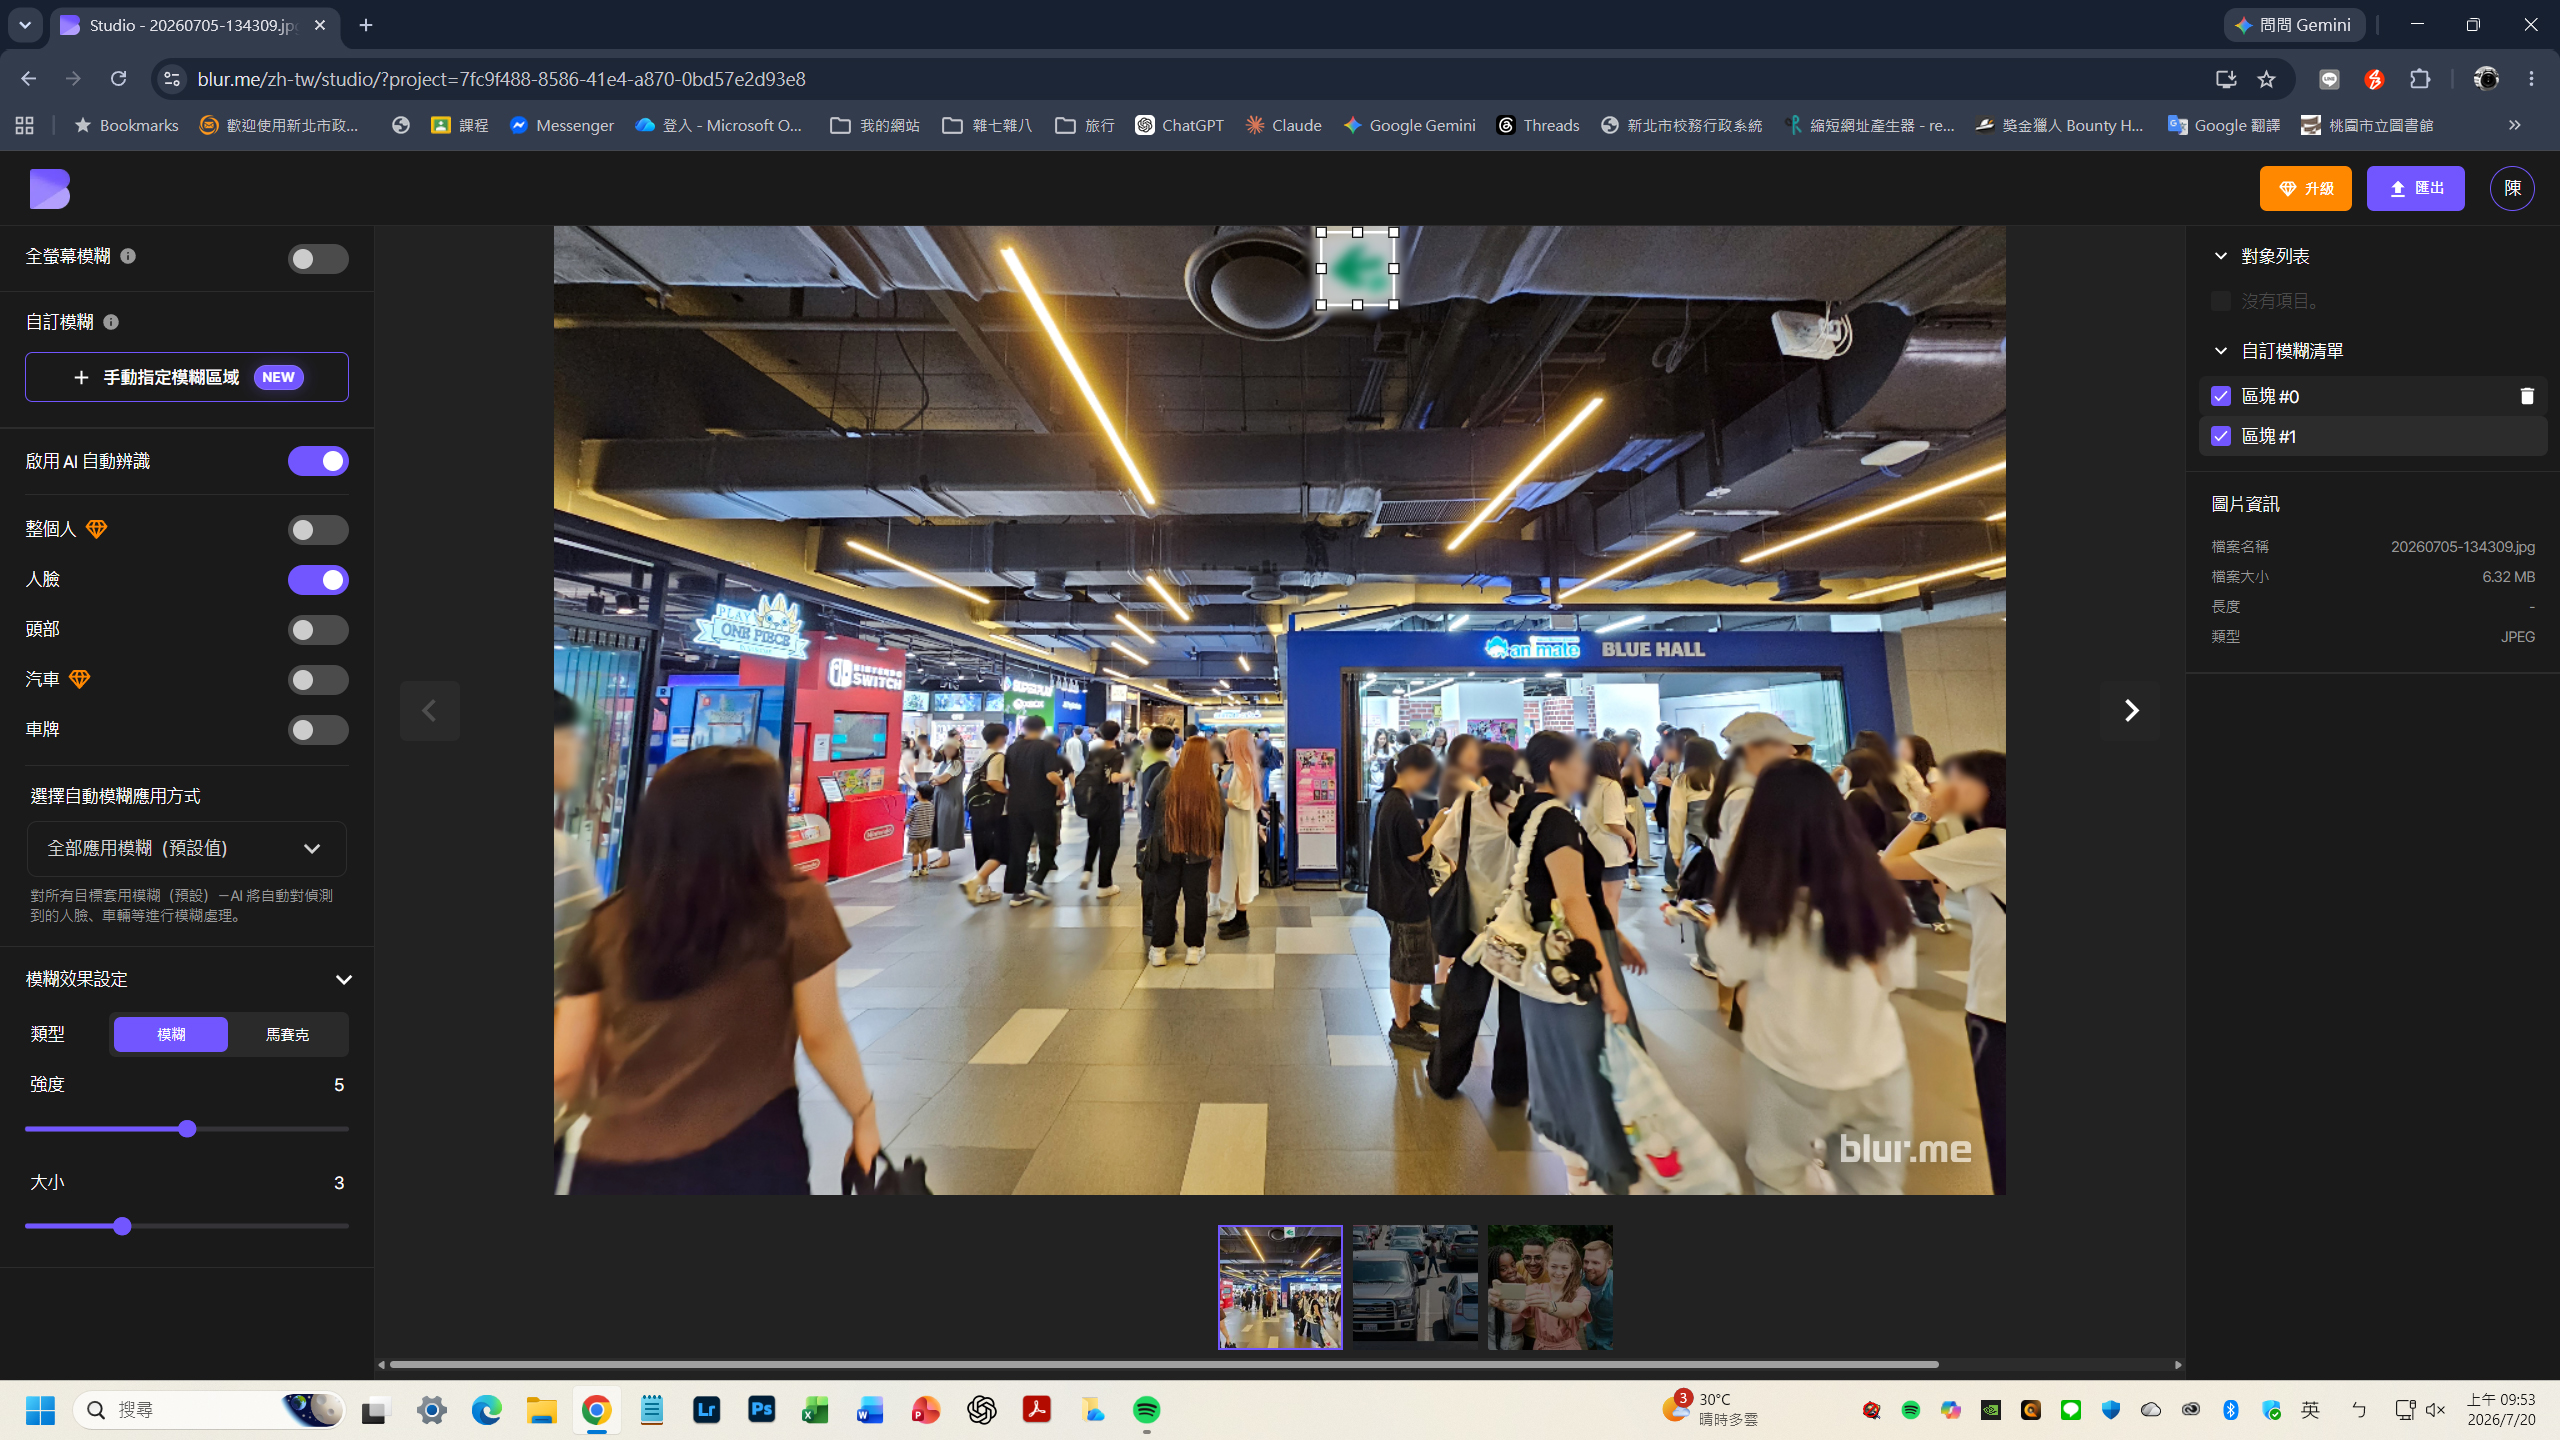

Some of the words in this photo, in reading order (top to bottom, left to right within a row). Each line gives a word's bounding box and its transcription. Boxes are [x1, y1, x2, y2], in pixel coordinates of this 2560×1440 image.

[91, 19, 135, 31] Studio
[2261, 18, 2291, 32] 問問
[2297, 18, 2350, 31] Gemini
[198, 72, 806, 90] blur.me/zh-tw/studio/?project=7fc9f488-8586-41e4-a870-0bd57e2d93e8
[101, 119, 179, 131] Bookmarks
[459, 119, 489, 132] 課程
[537, 120, 615, 135] Messenger
[663, 119, 692, 132] 登入
[707, 119, 774, 131] Microsoft
[860, 119, 920, 132] 我的網站
[973, 119, 1032, 132] 雜七雜八
[1085, 119, 1115, 132] 旅行
[1163, 119, 1224, 131] ChatGPT
[1273, 119, 1322, 131] Claude
[1370, 119, 1422, 135] Google
[1426, 119, 1475, 131] Gemini
[1524, 119, 1580, 131] Threads
[1628, 119, 1762, 132] 新北市校務行政系統
[1810, 119, 1915, 132] 縮短網址產生器
[2067, 120, 2117, 135] Bounty
[2195, 119, 2247, 135] Google
[2251, 119, 2280, 132] 翻譯
[2329, 118, 2434, 132] 桃園市立圖書館
[2305, 182, 2334, 195] 升級
[2416, 181, 2444, 194] 匯出
[2505, 180, 2522, 196] 陳
[25, 247, 110, 264] 全螢幕模糊
[2242, 248, 2310, 264] 對象列表
[2242, 292, 2316, 309] 沒有項目。
[27, 313, 93, 330] 自訂模糊
[2243, 342, 2344, 359] 自訂模糊清單
[103, 369, 240, 385] 手動指定模糊區域
[263, 372, 295, 382] NEW
[2241, 387, 2276, 404] 區塊
[2278, 390, 2299, 404] #0
[2241, 427, 2276, 444] 區塊
[2278, 430, 2295, 443] #1
[26, 453, 59, 469] 啟用
[63, 455, 77, 468] AI
[84, 452, 150, 469] 自動辨識
[2212, 495, 2280, 512] 圖片資訊
[25, 520, 77, 537] 整個人
[2212, 540, 2269, 553] 檔案名稱
[2391, 541, 2535, 555] 20260705-134309.jpg
[26, 571, 60, 587] 人臉
[2212, 570, 2269, 583] 檔案大小
[2483, 571, 2511, 582] 6.32
[2515, 571, 2535, 582] MB
[2211, 600, 2240, 613] 長度
[718, 606, 751, 622] PLAY
[26, 620, 60, 637] 頭部
[721, 622, 750, 640] ONE
[754, 629, 791, 647] PIECE
[2212, 630, 2240, 643] 類型
[2501, 631, 2535, 642] JPEG
[1510, 638, 1580, 658] animate
[1602, 641, 1650, 657] BLUE
[1655, 641, 1706, 657] HALL
[854, 663, 903, 678] NINTENDO
[26, 671, 60, 687] 汽車
[853, 673, 903, 691] SWITCH
[25, 721, 60, 737] 車牌
[31, 787, 201, 804] 選擇自動模糊應用方式
[246, 889, 333, 902] 將自動對偵測
[30, 908, 238, 922] 到的人臉、車輛等進行模糊處理。
[26, 970, 128, 987] 模糊效果設定
[31, 1026, 65, 1042] 類型
[157, 1027, 185, 1041] 模糊
[266, 1028, 309, 1041] 馬賽克
[30, 1076, 65, 1092] 強度
[335, 1078, 344, 1092] 5
[31, 1174, 65, 1190] 大小
[334, 1176, 344, 1190] 3
[1680, 1393, 1687, 1403] 3
[1701, 1394, 1730, 1405] 30°C
[2467, 1393, 2495, 1406] 上午
[2501, 1394, 2535, 1405] 09:53
[119, 1401, 153, 1418] 搜尋
[699, 1403, 715, 1416] Lr
[752, 1402, 772, 1415] Ps
[804, 1411, 812, 1420] X
[858, 1411, 868, 1420] W
[915, 1411, 922, 1420] P
[2301, 1401, 2320, 1419] 英
[1700, 1412, 1758, 1426] 晴時多雲
[2468, 1414, 2535, 1427] 2026/7/20
